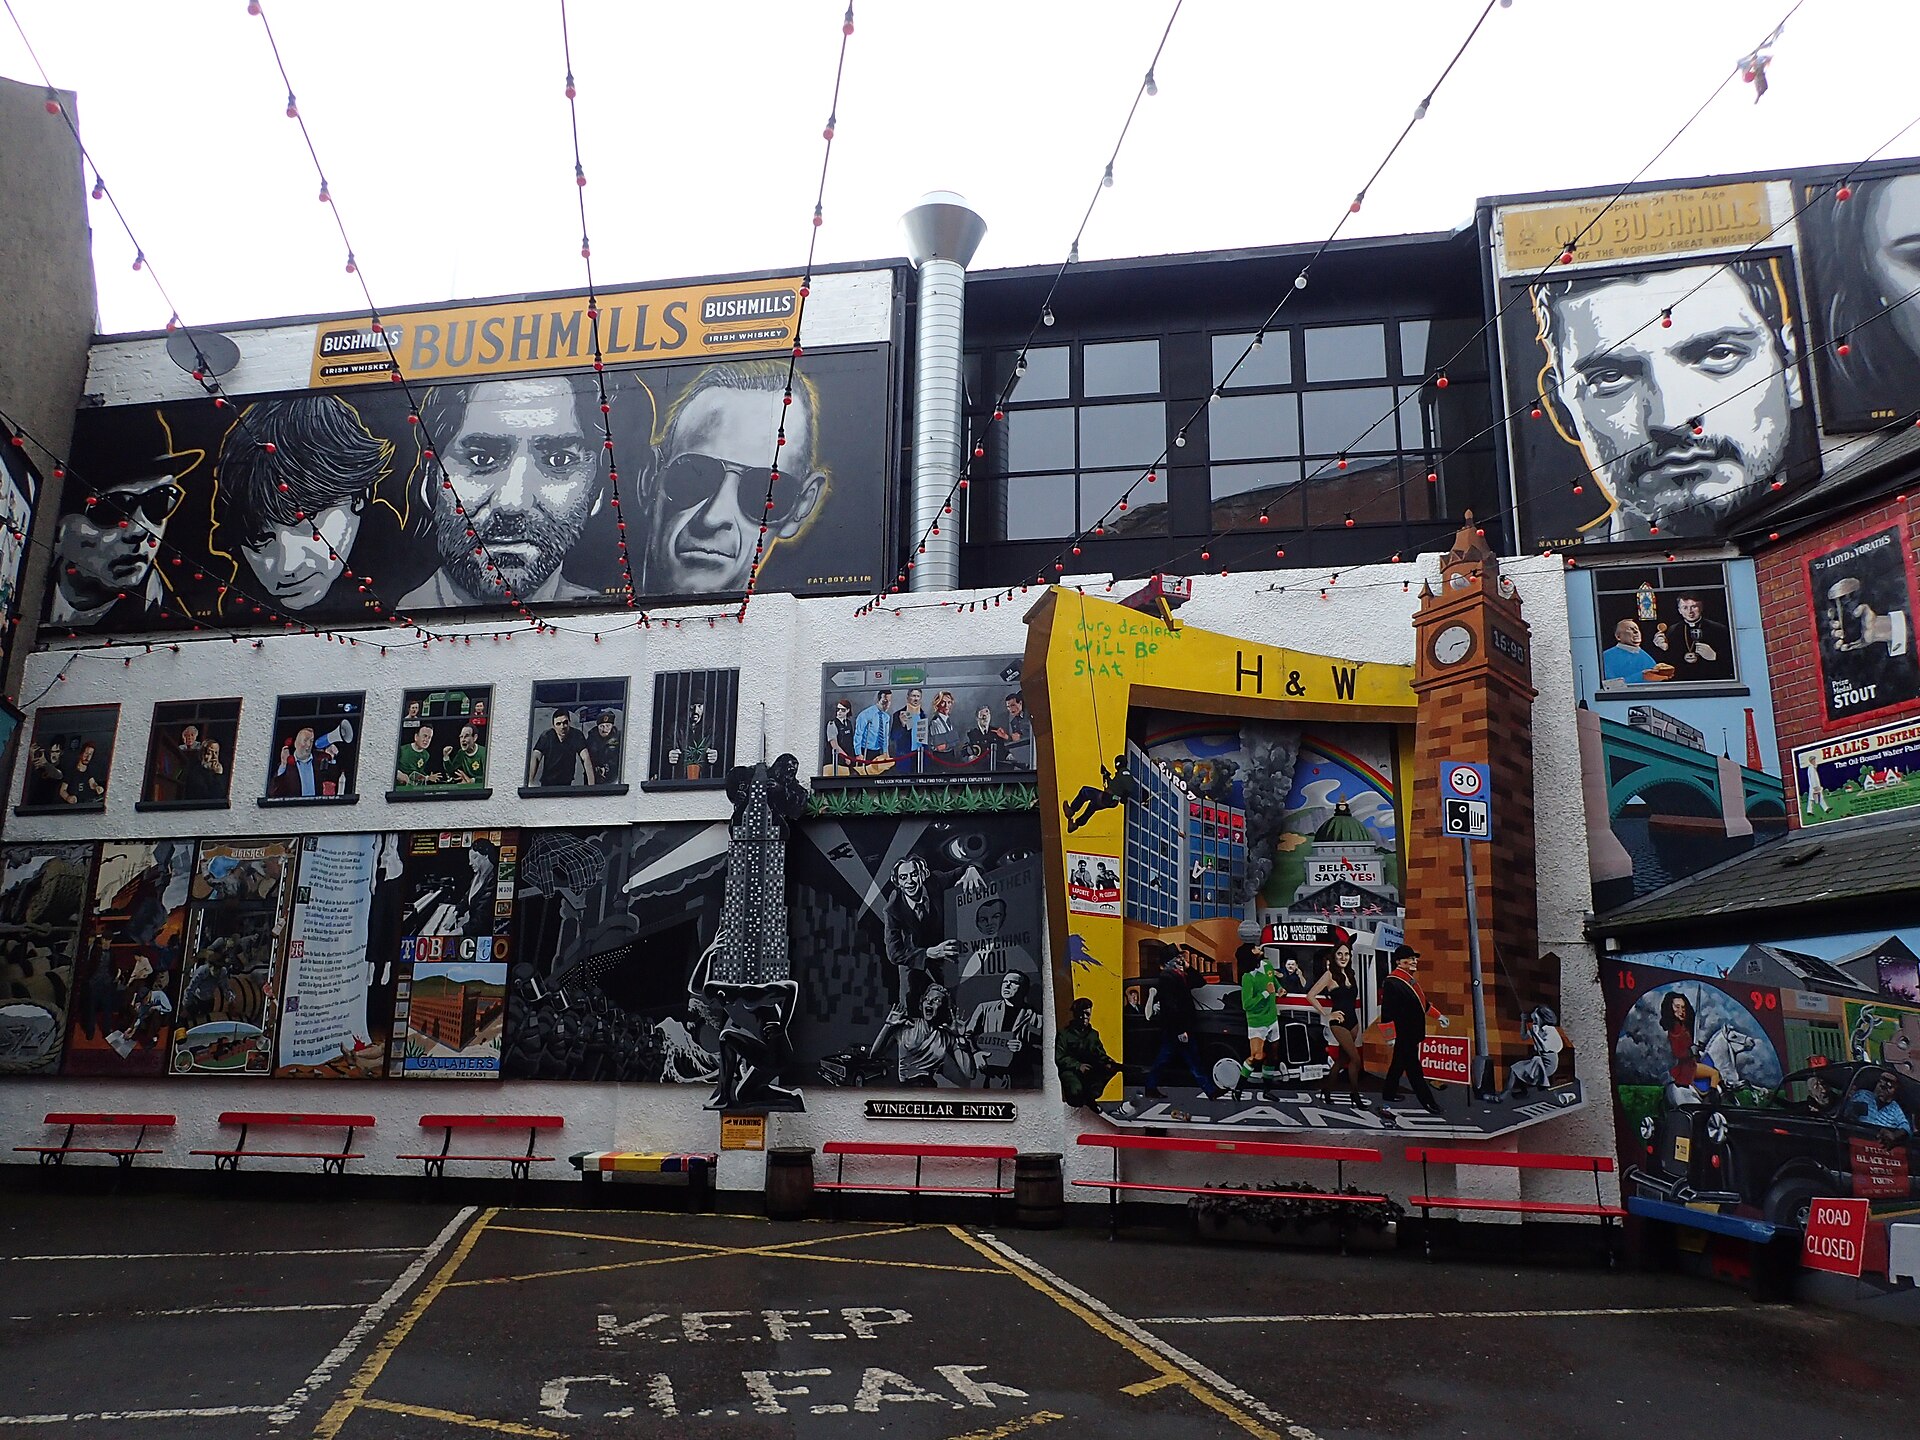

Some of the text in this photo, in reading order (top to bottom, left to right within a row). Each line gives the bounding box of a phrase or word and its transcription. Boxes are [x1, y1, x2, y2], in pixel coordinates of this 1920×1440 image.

[1672, 193, 1695, 203] The
[1701, 190, 1725, 200] Age
[1554, 200, 1762, 249] OLD BUSHMILLS
[1595, 250, 1615, 258] THE
[1669, 239, 1704, 250] GREAT
[705, 295, 792, 318] BUSHMILLS
[323, 330, 400, 352] BUSHMILLS
[408, 301, 689, 371] BUSHMILLS
[709, 330, 782, 342] IRISH WHISKEY
[325, 363, 390, 375] IRISH WHISKEY
[1826, 552, 1850, 568] LLOYD
[1236, 651, 1356, 700] H & W
[1834, 685, 1877, 709] STOUT
[1821, 738, 1870, 760] HALL'S
[1834, 760, 1847, 768] The
[1860, 753, 1881, 763] Bound
[1882, 748, 1903, 757] Water
[1454, 773, 1477, 787] 30
[1318, 863, 1369, 872] BELFAST
[1314, 873, 1376, 882] SAYS YES!
[957, 869, 1032, 907] BIG BROTHER
[971, 931, 1030, 951] WATCHING
[1273, 925, 1289, 941] 118
[401, 937, 509, 960] TOBACCO
[978, 951, 1007, 975] YOU
[1617, 970, 1635, 989] 16
[1751, 992, 1776, 1010] 90
[1423, 1040, 1464, 1056] bóthar
[417, 1059, 495, 1069] GALLAHERS
[1421, 1057, 1467, 1072] druidte
[872, 1103, 1006, 1116] WINECELLAR ENTRY
[1136, 1102, 1483, 1131] LANE
[1818, 1208, 1851, 1226] ROAD
[1807, 1235, 1855, 1261] CLOSED
[597, 1307, 913, 1345] KEEP
